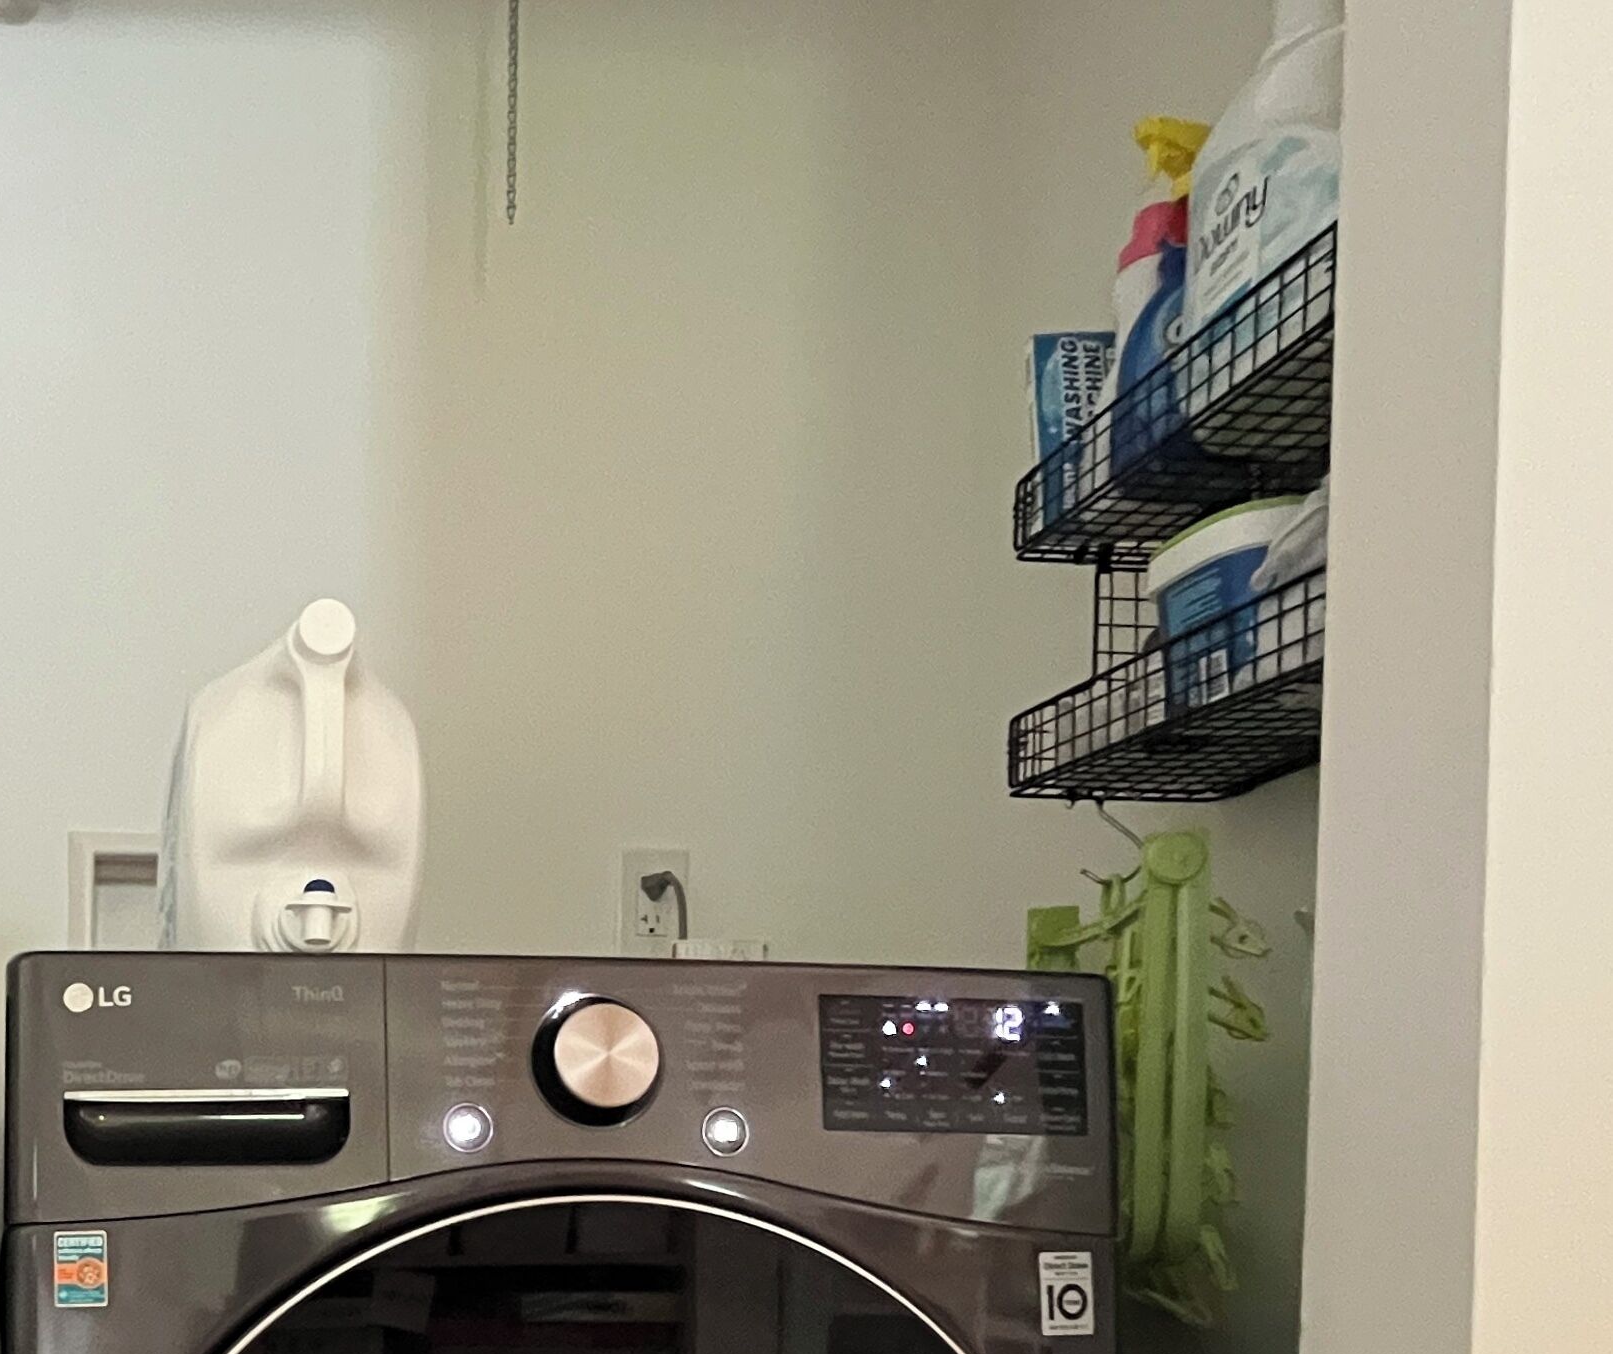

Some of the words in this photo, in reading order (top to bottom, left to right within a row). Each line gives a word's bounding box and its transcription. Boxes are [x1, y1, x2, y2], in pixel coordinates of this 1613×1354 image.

[1060, 340, 1084, 443] WASHING
[97, 985, 133, 1008] LG
[291, 985, 345, 1003] ThinQ
[1046, 1283, 1088, 1321] 10
